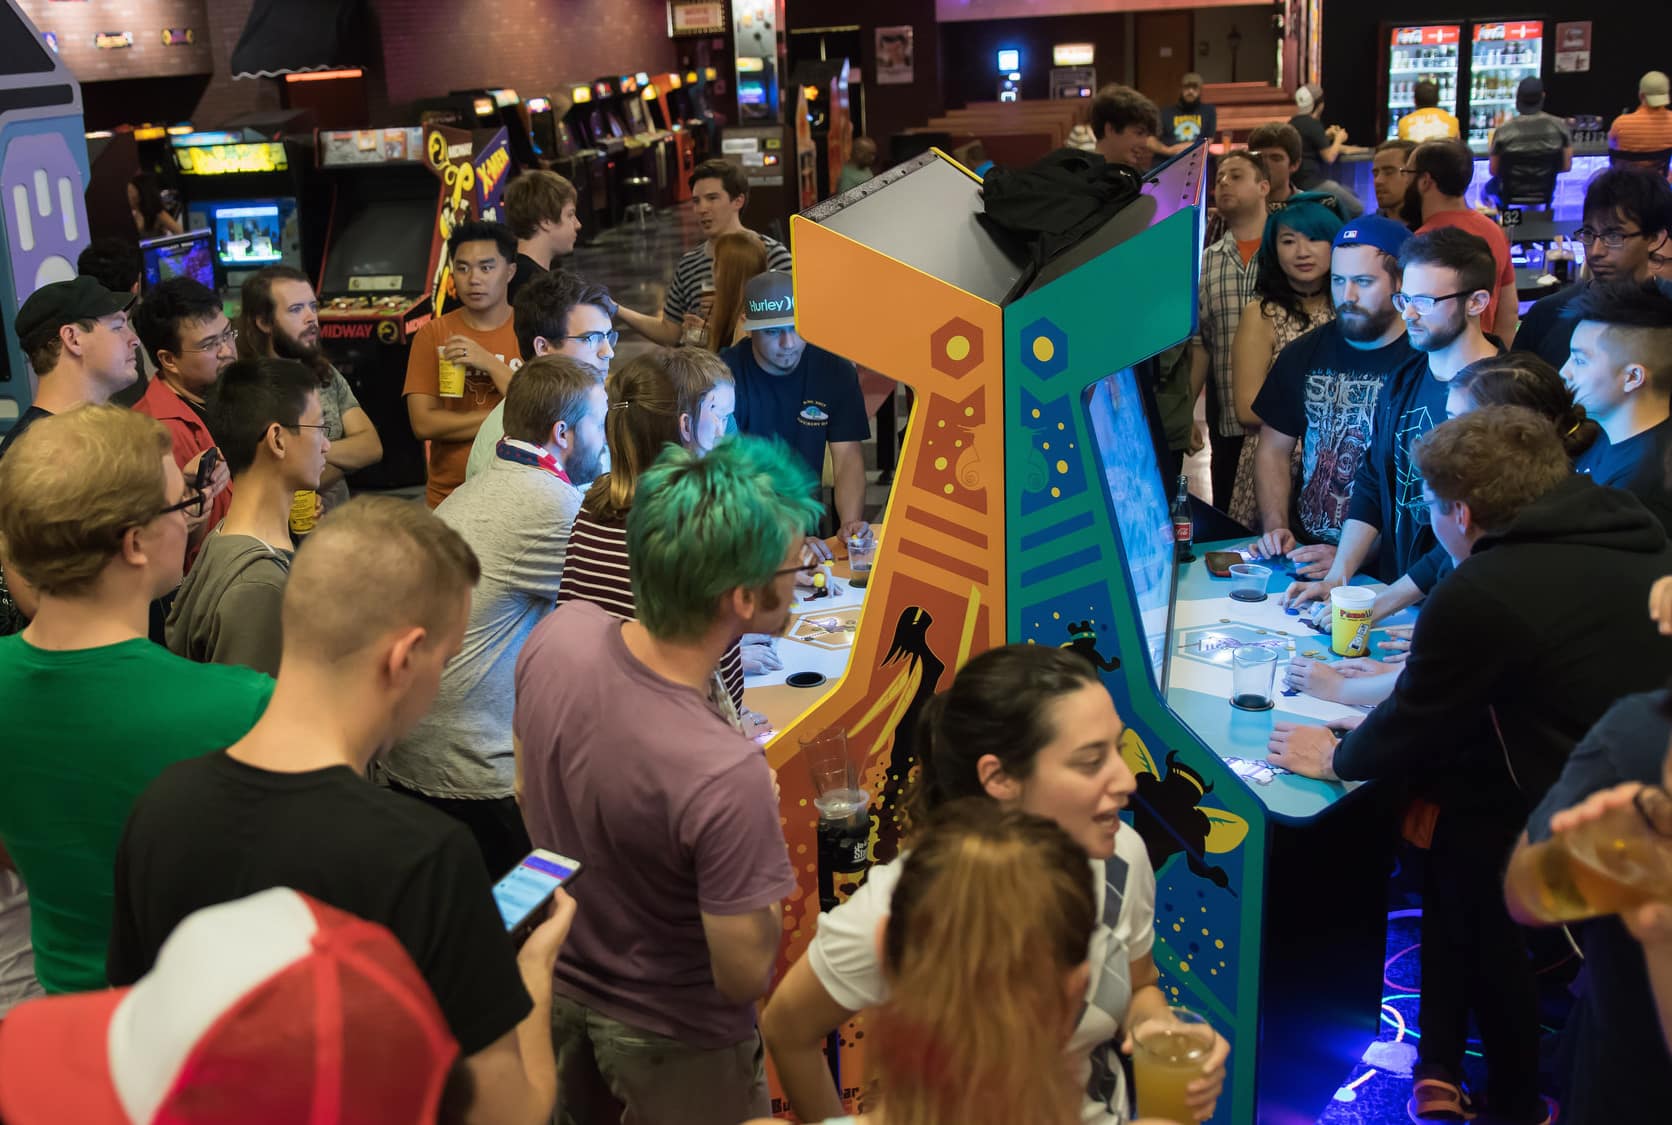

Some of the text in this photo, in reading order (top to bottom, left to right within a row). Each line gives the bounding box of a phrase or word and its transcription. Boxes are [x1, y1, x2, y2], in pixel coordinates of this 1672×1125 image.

[1504, 210, 1520, 224] 32
[749, 299, 784, 312] Hurley
[319, 323, 373, 338] MIDWAY
